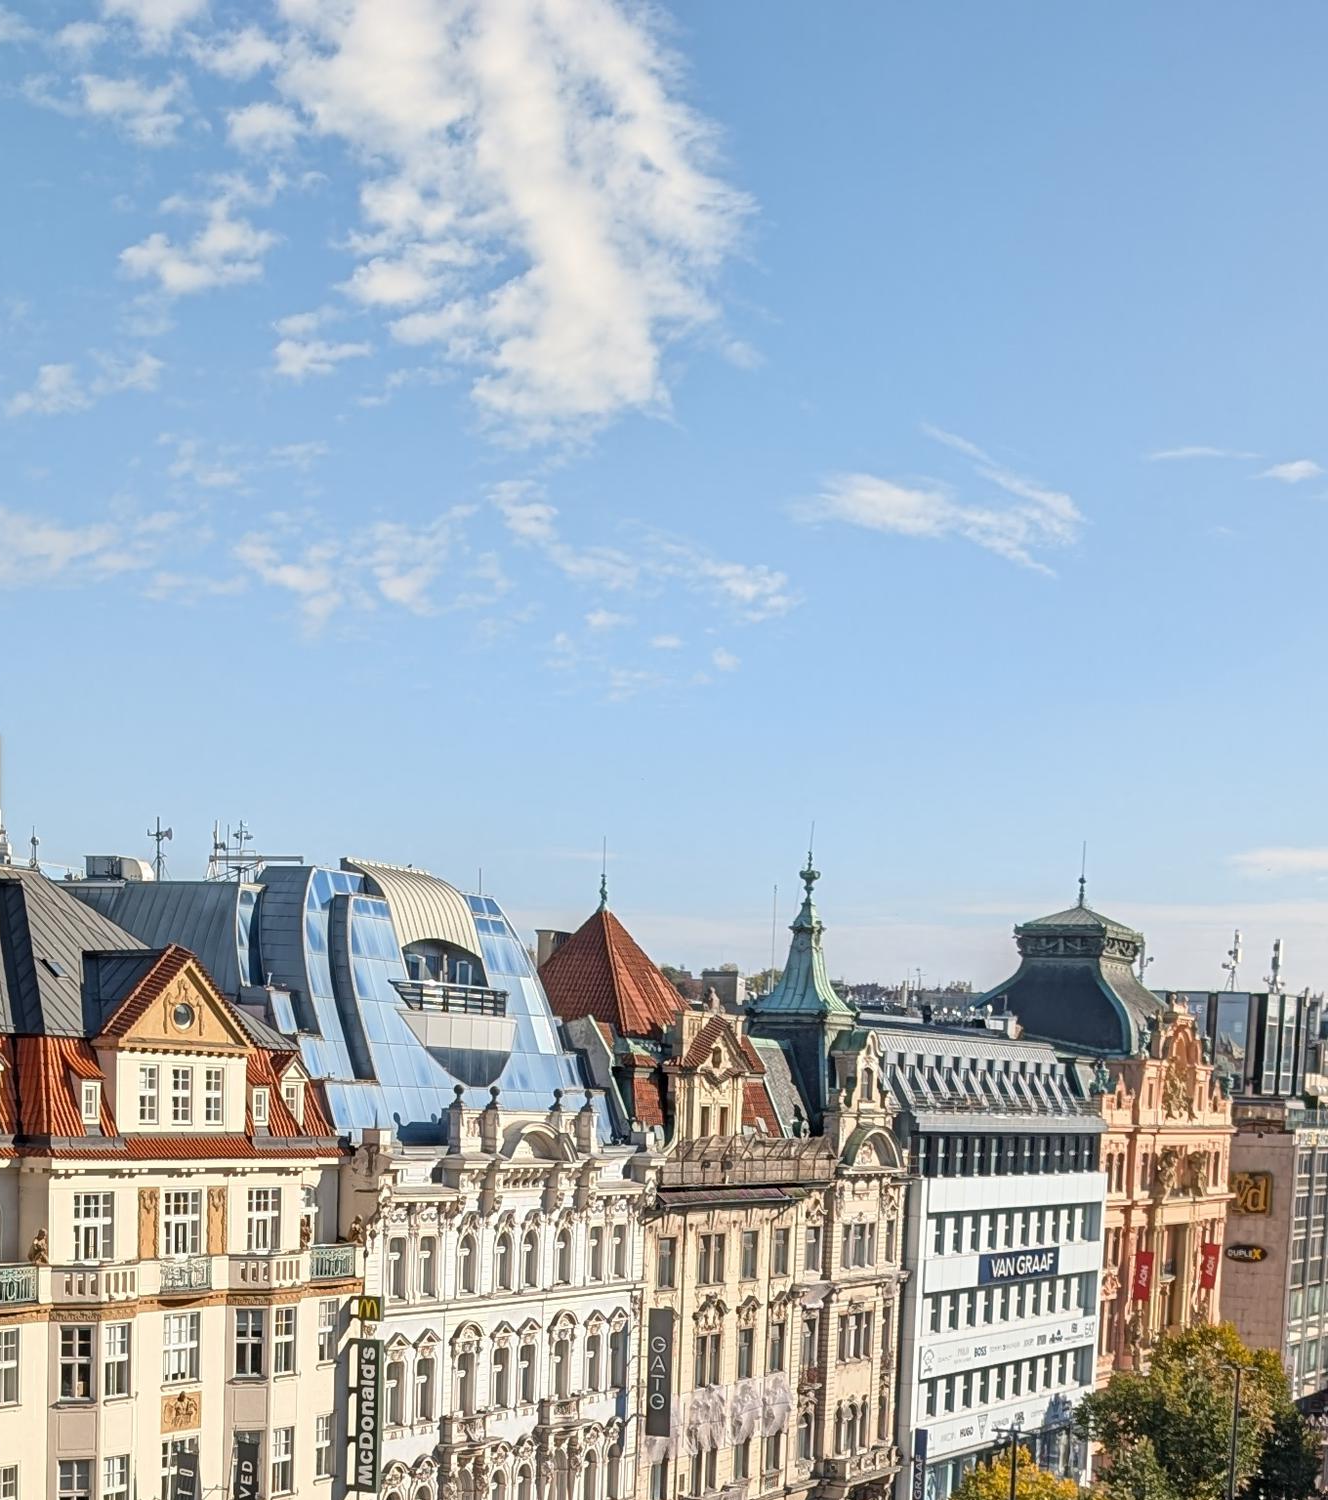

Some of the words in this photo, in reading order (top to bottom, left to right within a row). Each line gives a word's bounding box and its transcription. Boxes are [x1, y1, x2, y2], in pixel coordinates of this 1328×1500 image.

[991, 1256, 1015, 1278] VAN
[1016, 1252, 1054, 1275] GRAAF
[1227, 1248, 1262, 1260] DUPLEX
[358, 1347, 376, 1487] McDonald's
[914, 1454, 925, 1500] GRAAF
